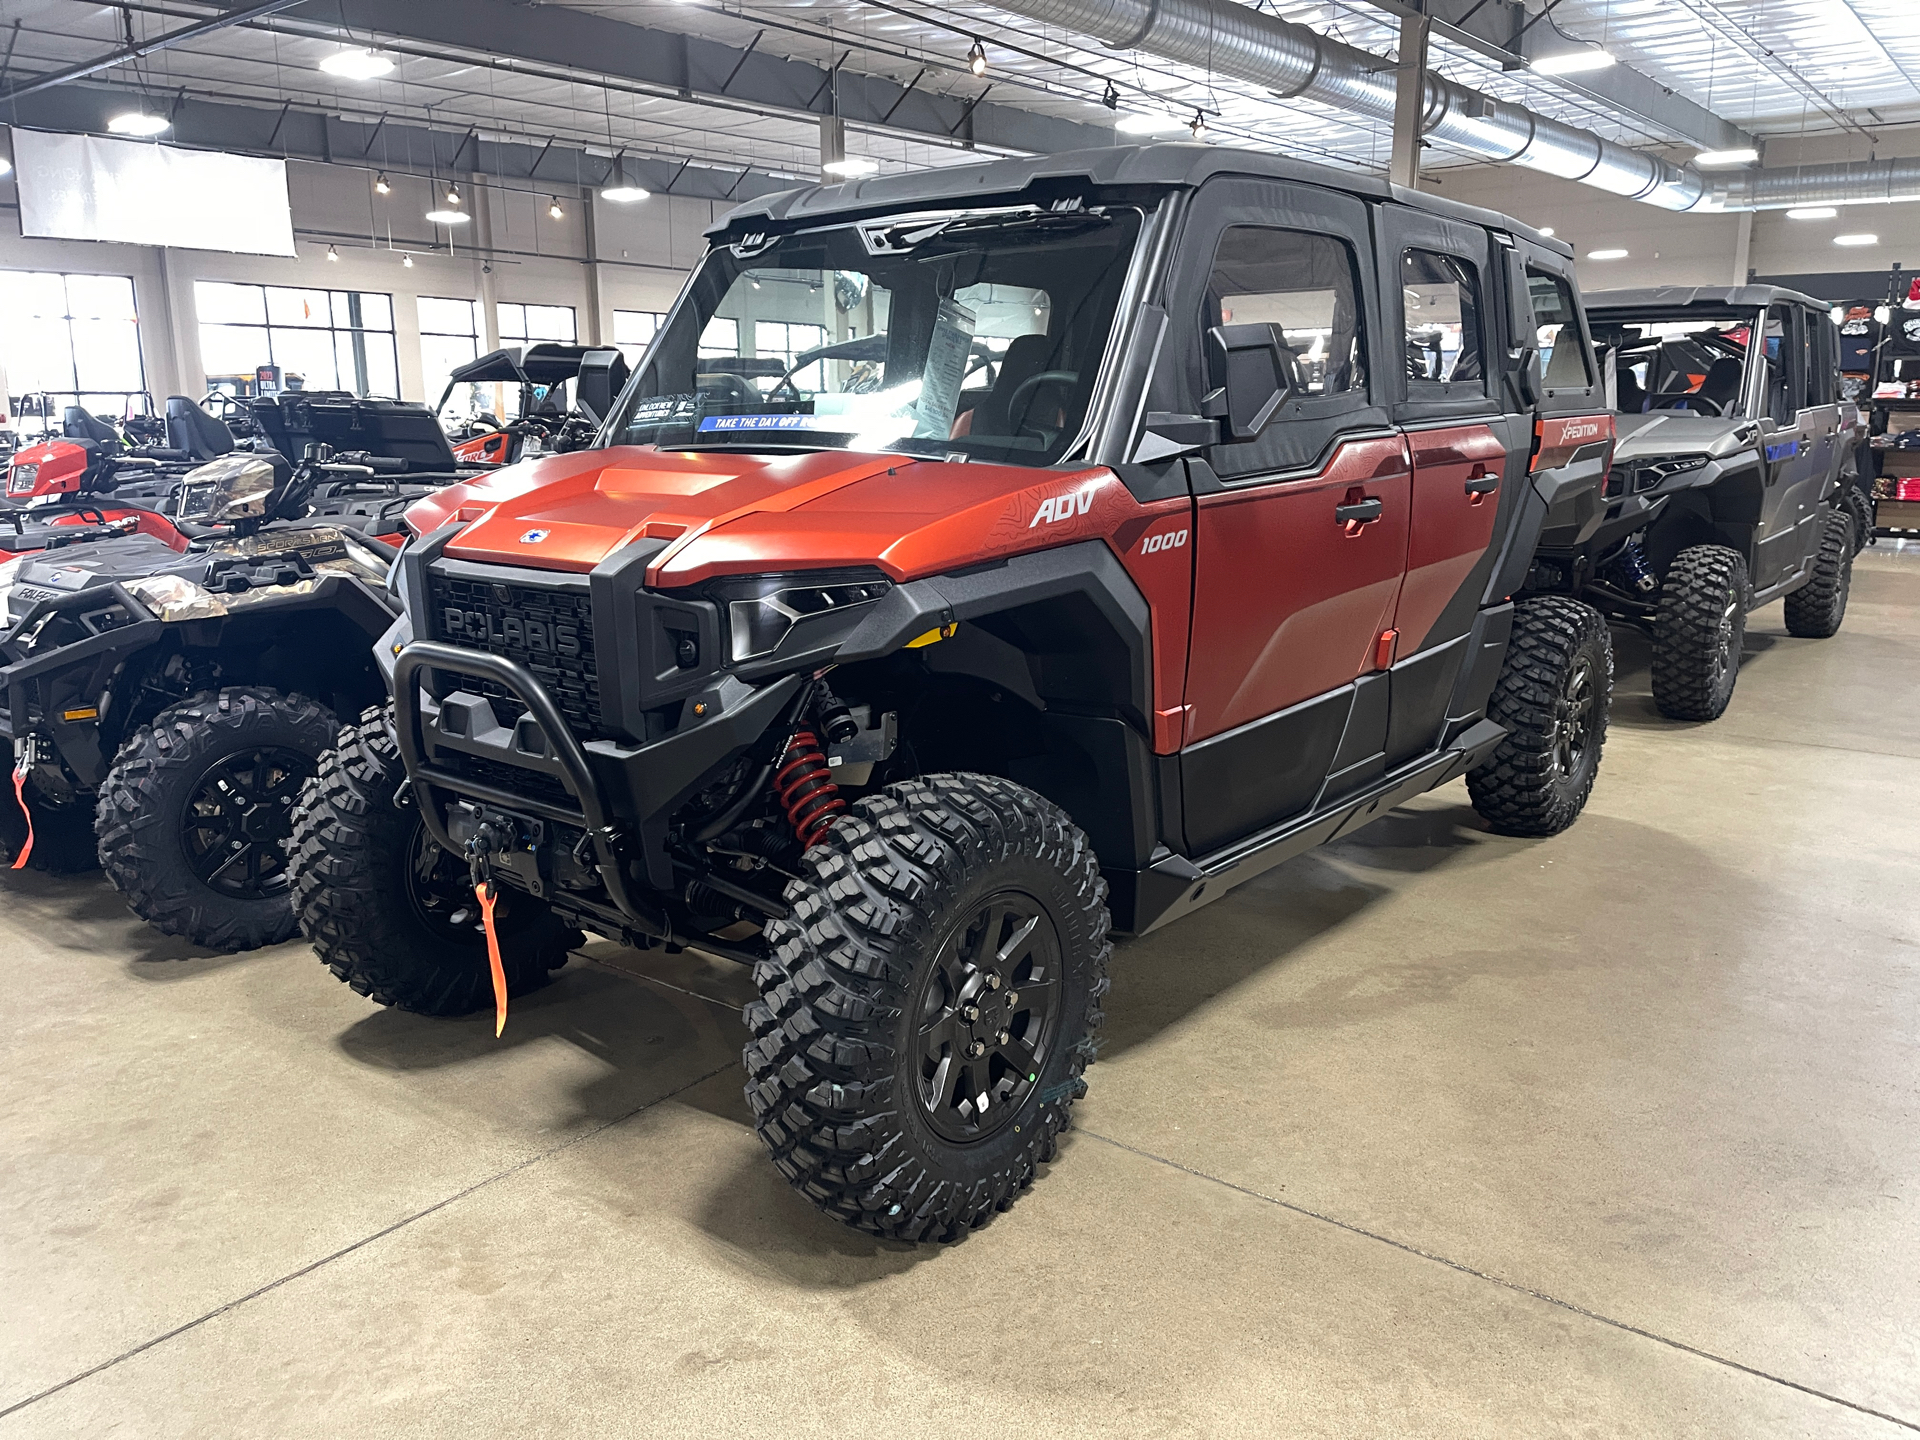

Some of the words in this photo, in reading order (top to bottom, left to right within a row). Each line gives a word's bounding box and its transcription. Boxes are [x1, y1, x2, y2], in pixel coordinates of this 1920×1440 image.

[715, 418, 739, 428] TAKE
[739, 418, 756, 427] THE
[758, 417, 779, 427] DAY
[778, 417, 801, 427] OFF
[799, 417, 818, 427] RO
[1559, 421, 1598, 445] XPEDITION
[1028, 490, 1096, 528] ADV
[1140, 529, 1188, 555] 1000
[444, 607, 581, 655] POLARIS
